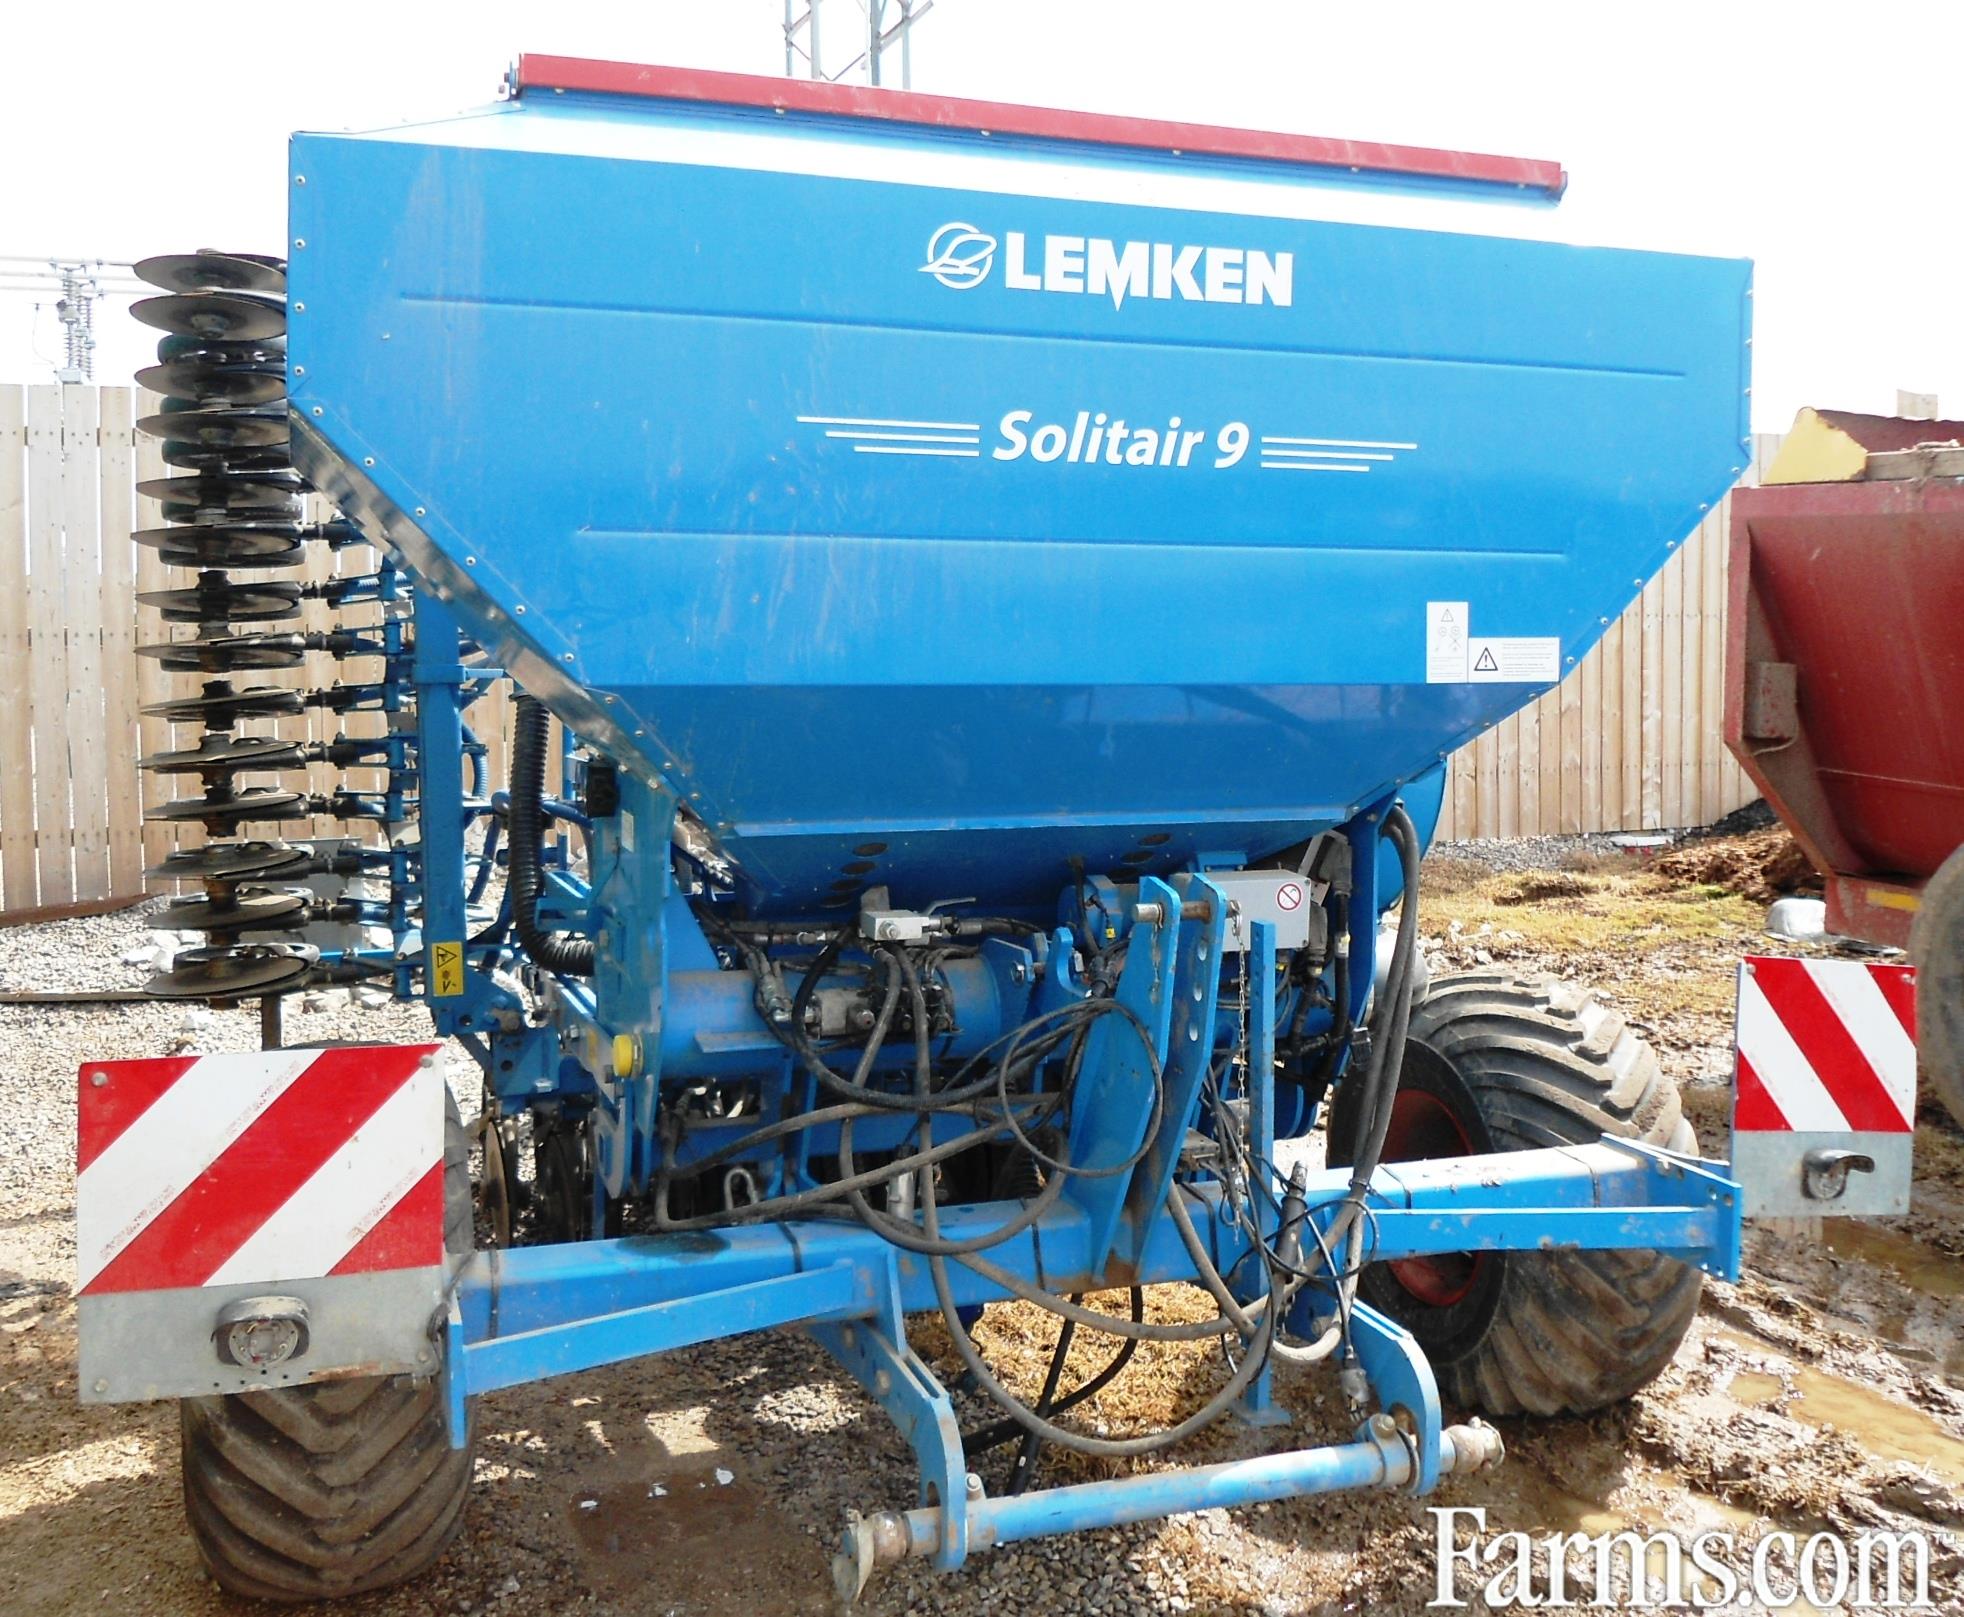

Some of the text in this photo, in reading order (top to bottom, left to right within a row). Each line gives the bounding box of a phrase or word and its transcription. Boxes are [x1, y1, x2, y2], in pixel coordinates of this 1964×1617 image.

[1005, 231, 1294, 311] LEMKEN
[992, 410, 1250, 468] Solitair 9
